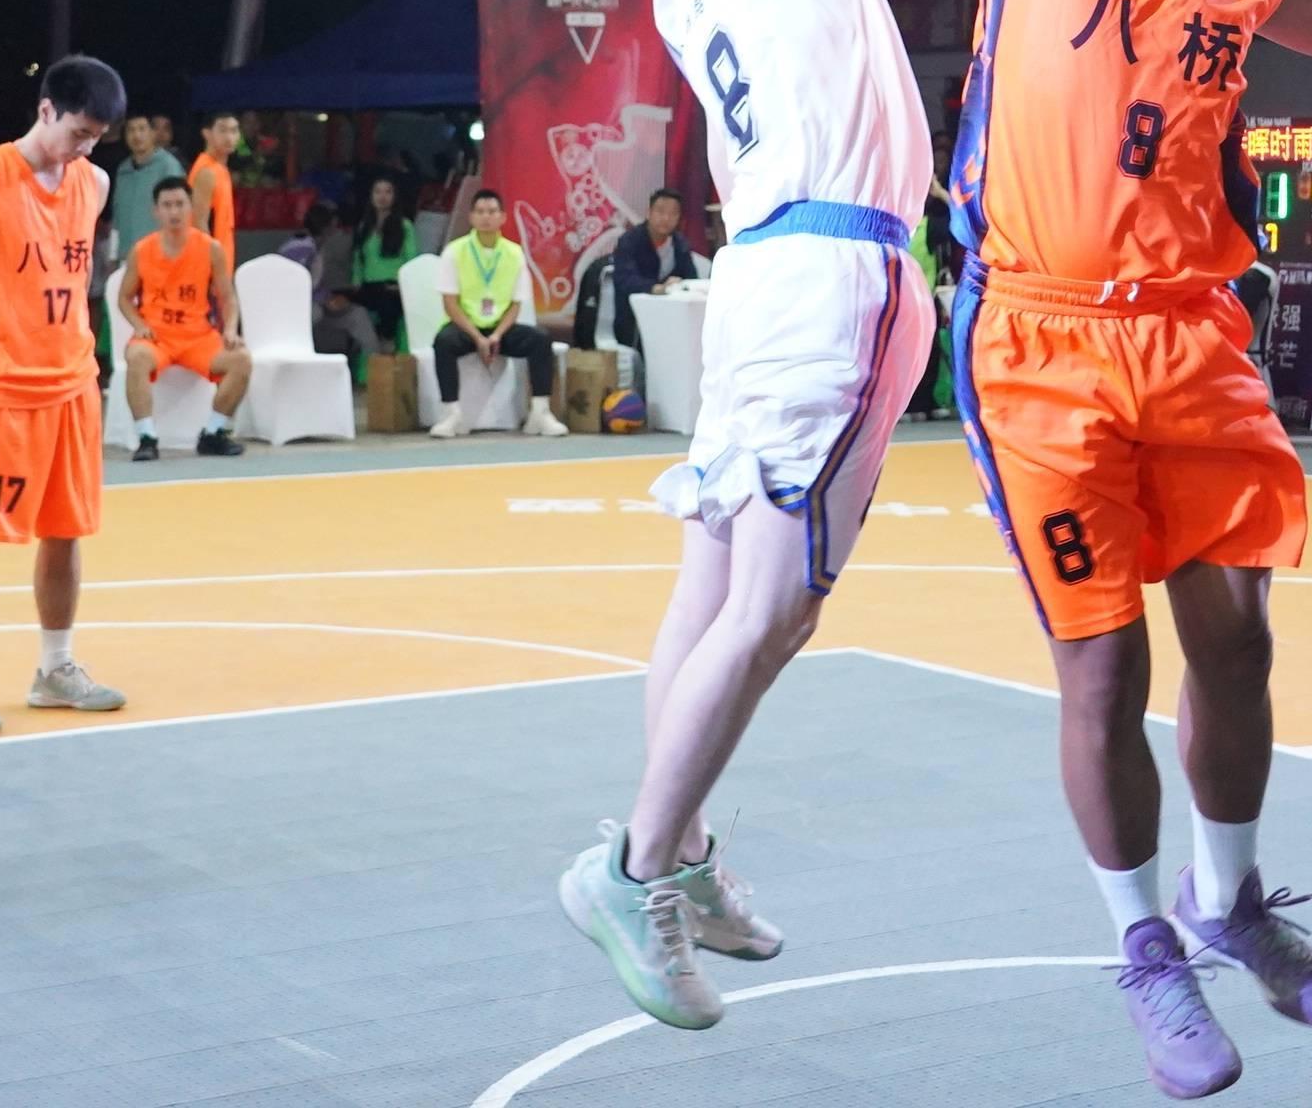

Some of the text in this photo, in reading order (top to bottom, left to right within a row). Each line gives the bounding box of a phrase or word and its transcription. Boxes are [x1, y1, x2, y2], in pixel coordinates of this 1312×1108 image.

[704, 24, 760, 163] 8
[1117, 99, 1167, 179] 8
[17, 239, 89, 274] 八桥
[44, 288, 73, 325] 17
[1041, 509, 1095, 586] 8
